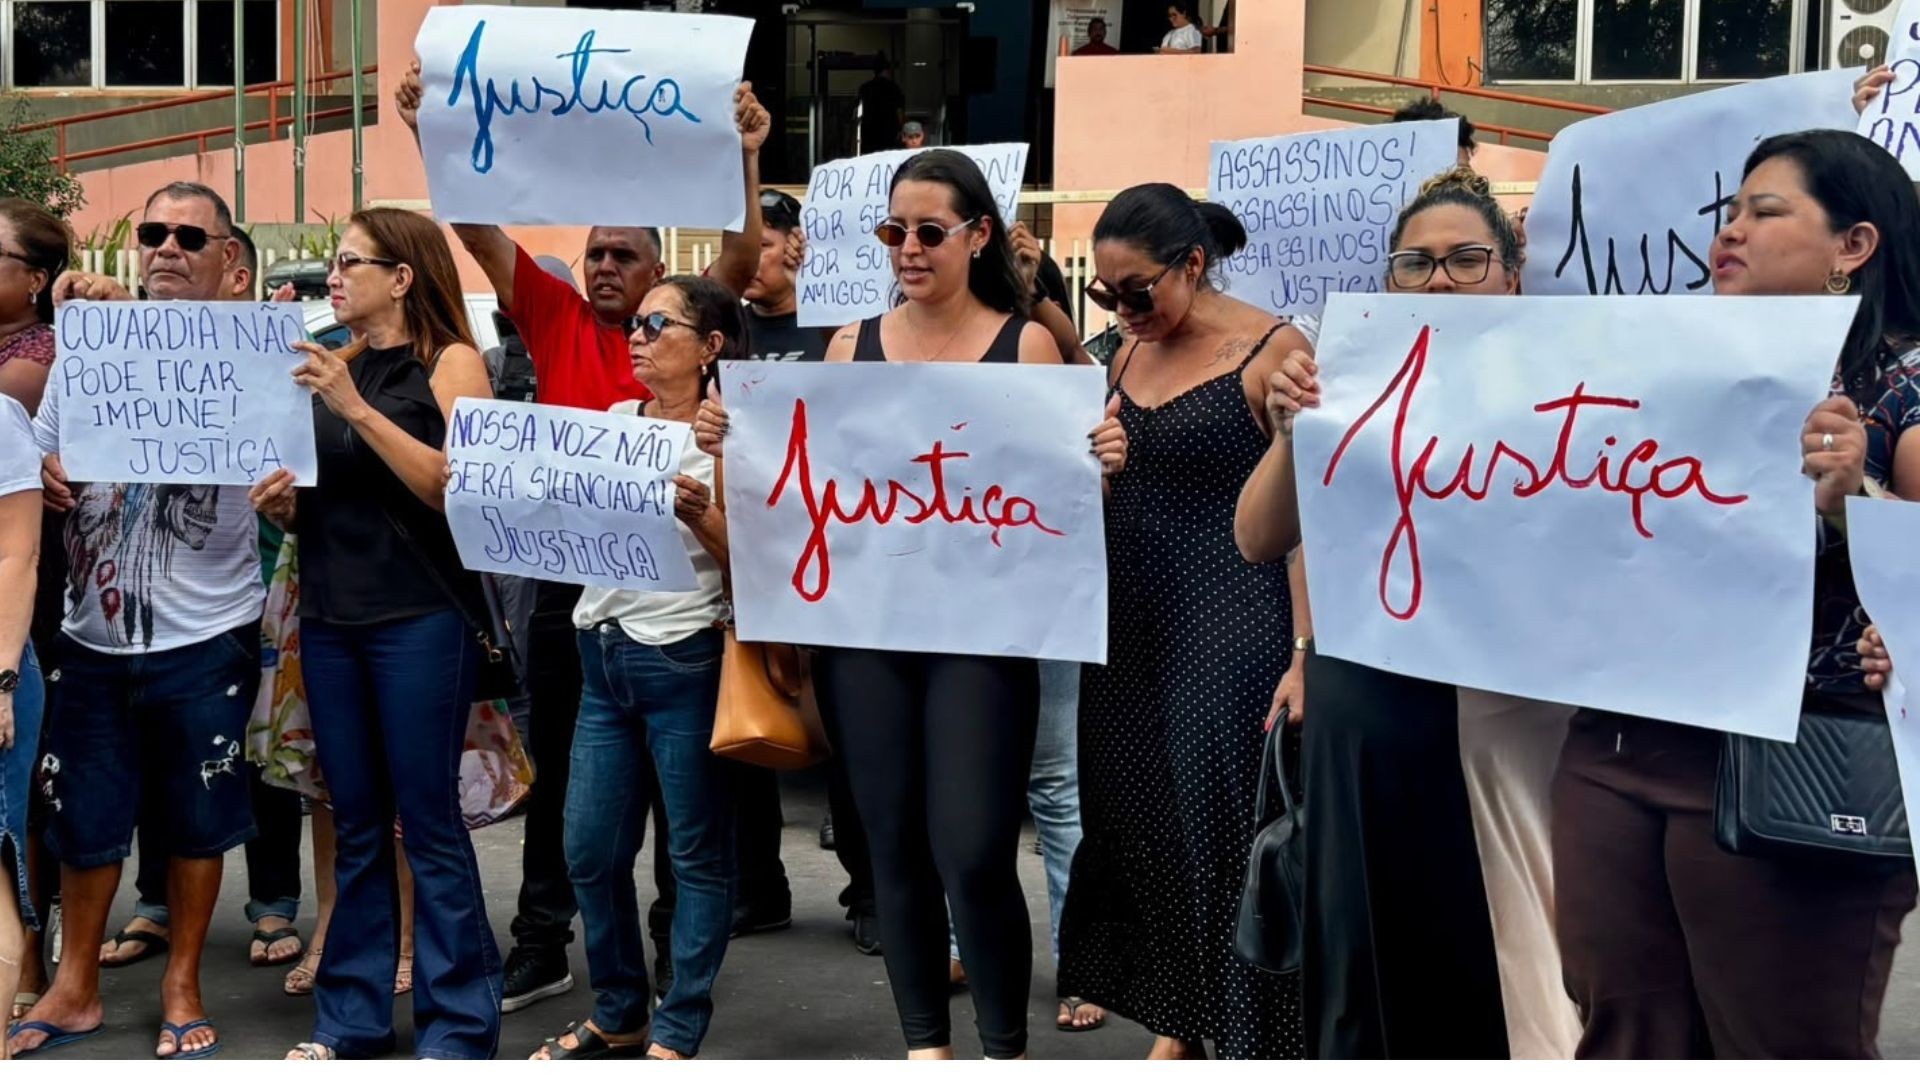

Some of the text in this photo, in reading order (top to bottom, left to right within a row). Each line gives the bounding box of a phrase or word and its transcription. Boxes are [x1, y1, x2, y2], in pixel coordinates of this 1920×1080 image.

[447, 19, 702, 174] Justiça
[811, 165, 855, 202] POR
[1217, 131, 1417, 192] ASSASSINOS!
[804, 207, 845, 241] POR
[1219, 181, 1407, 235] SSASSiNOS!
[801, 245, 840, 279] POR
[801, 278, 882, 306] AMIGOS.
[232, 303, 302, 355] NÃO
[63, 355, 244, 397] PODE FICAR
[93, 395, 237, 430] IMPUNE!
[450, 407, 673, 472] NOSSA VOZ NÃO
[448, 458, 667, 517] SERÁ SILENCIADA!
[1322, 323, 1749, 621] Justiça
[766, 397, 1068, 602] Justiça
[481, 505, 660, 581] JUSTIÇA
